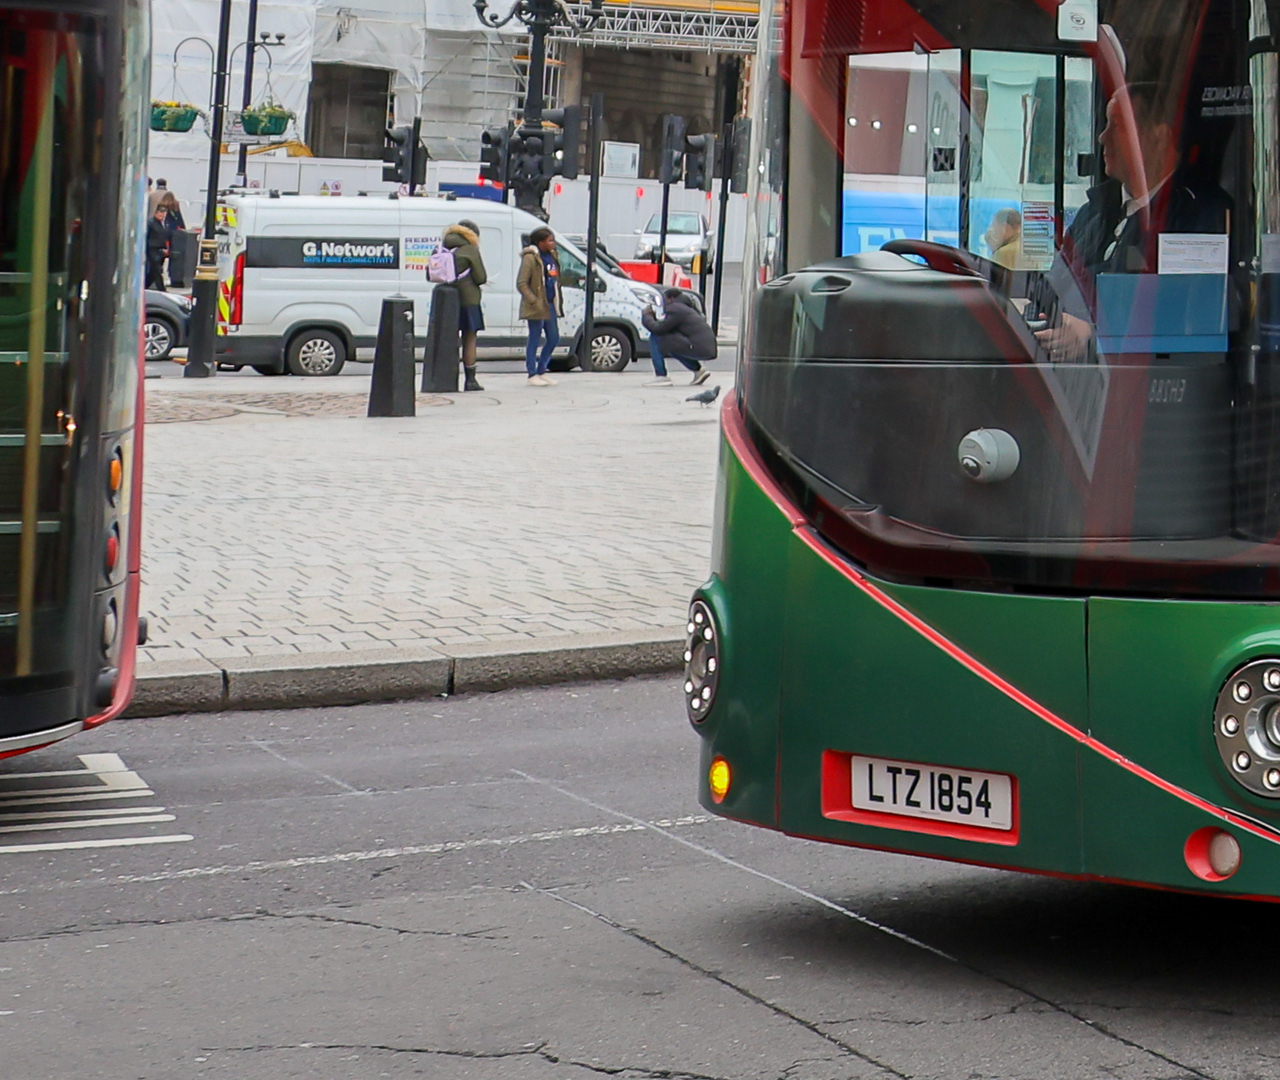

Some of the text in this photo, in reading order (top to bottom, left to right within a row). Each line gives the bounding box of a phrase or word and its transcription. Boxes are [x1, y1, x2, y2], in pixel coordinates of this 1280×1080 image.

[303, 241, 394, 258] G.Network
[868, 763, 992, 819] LTZ 1854
